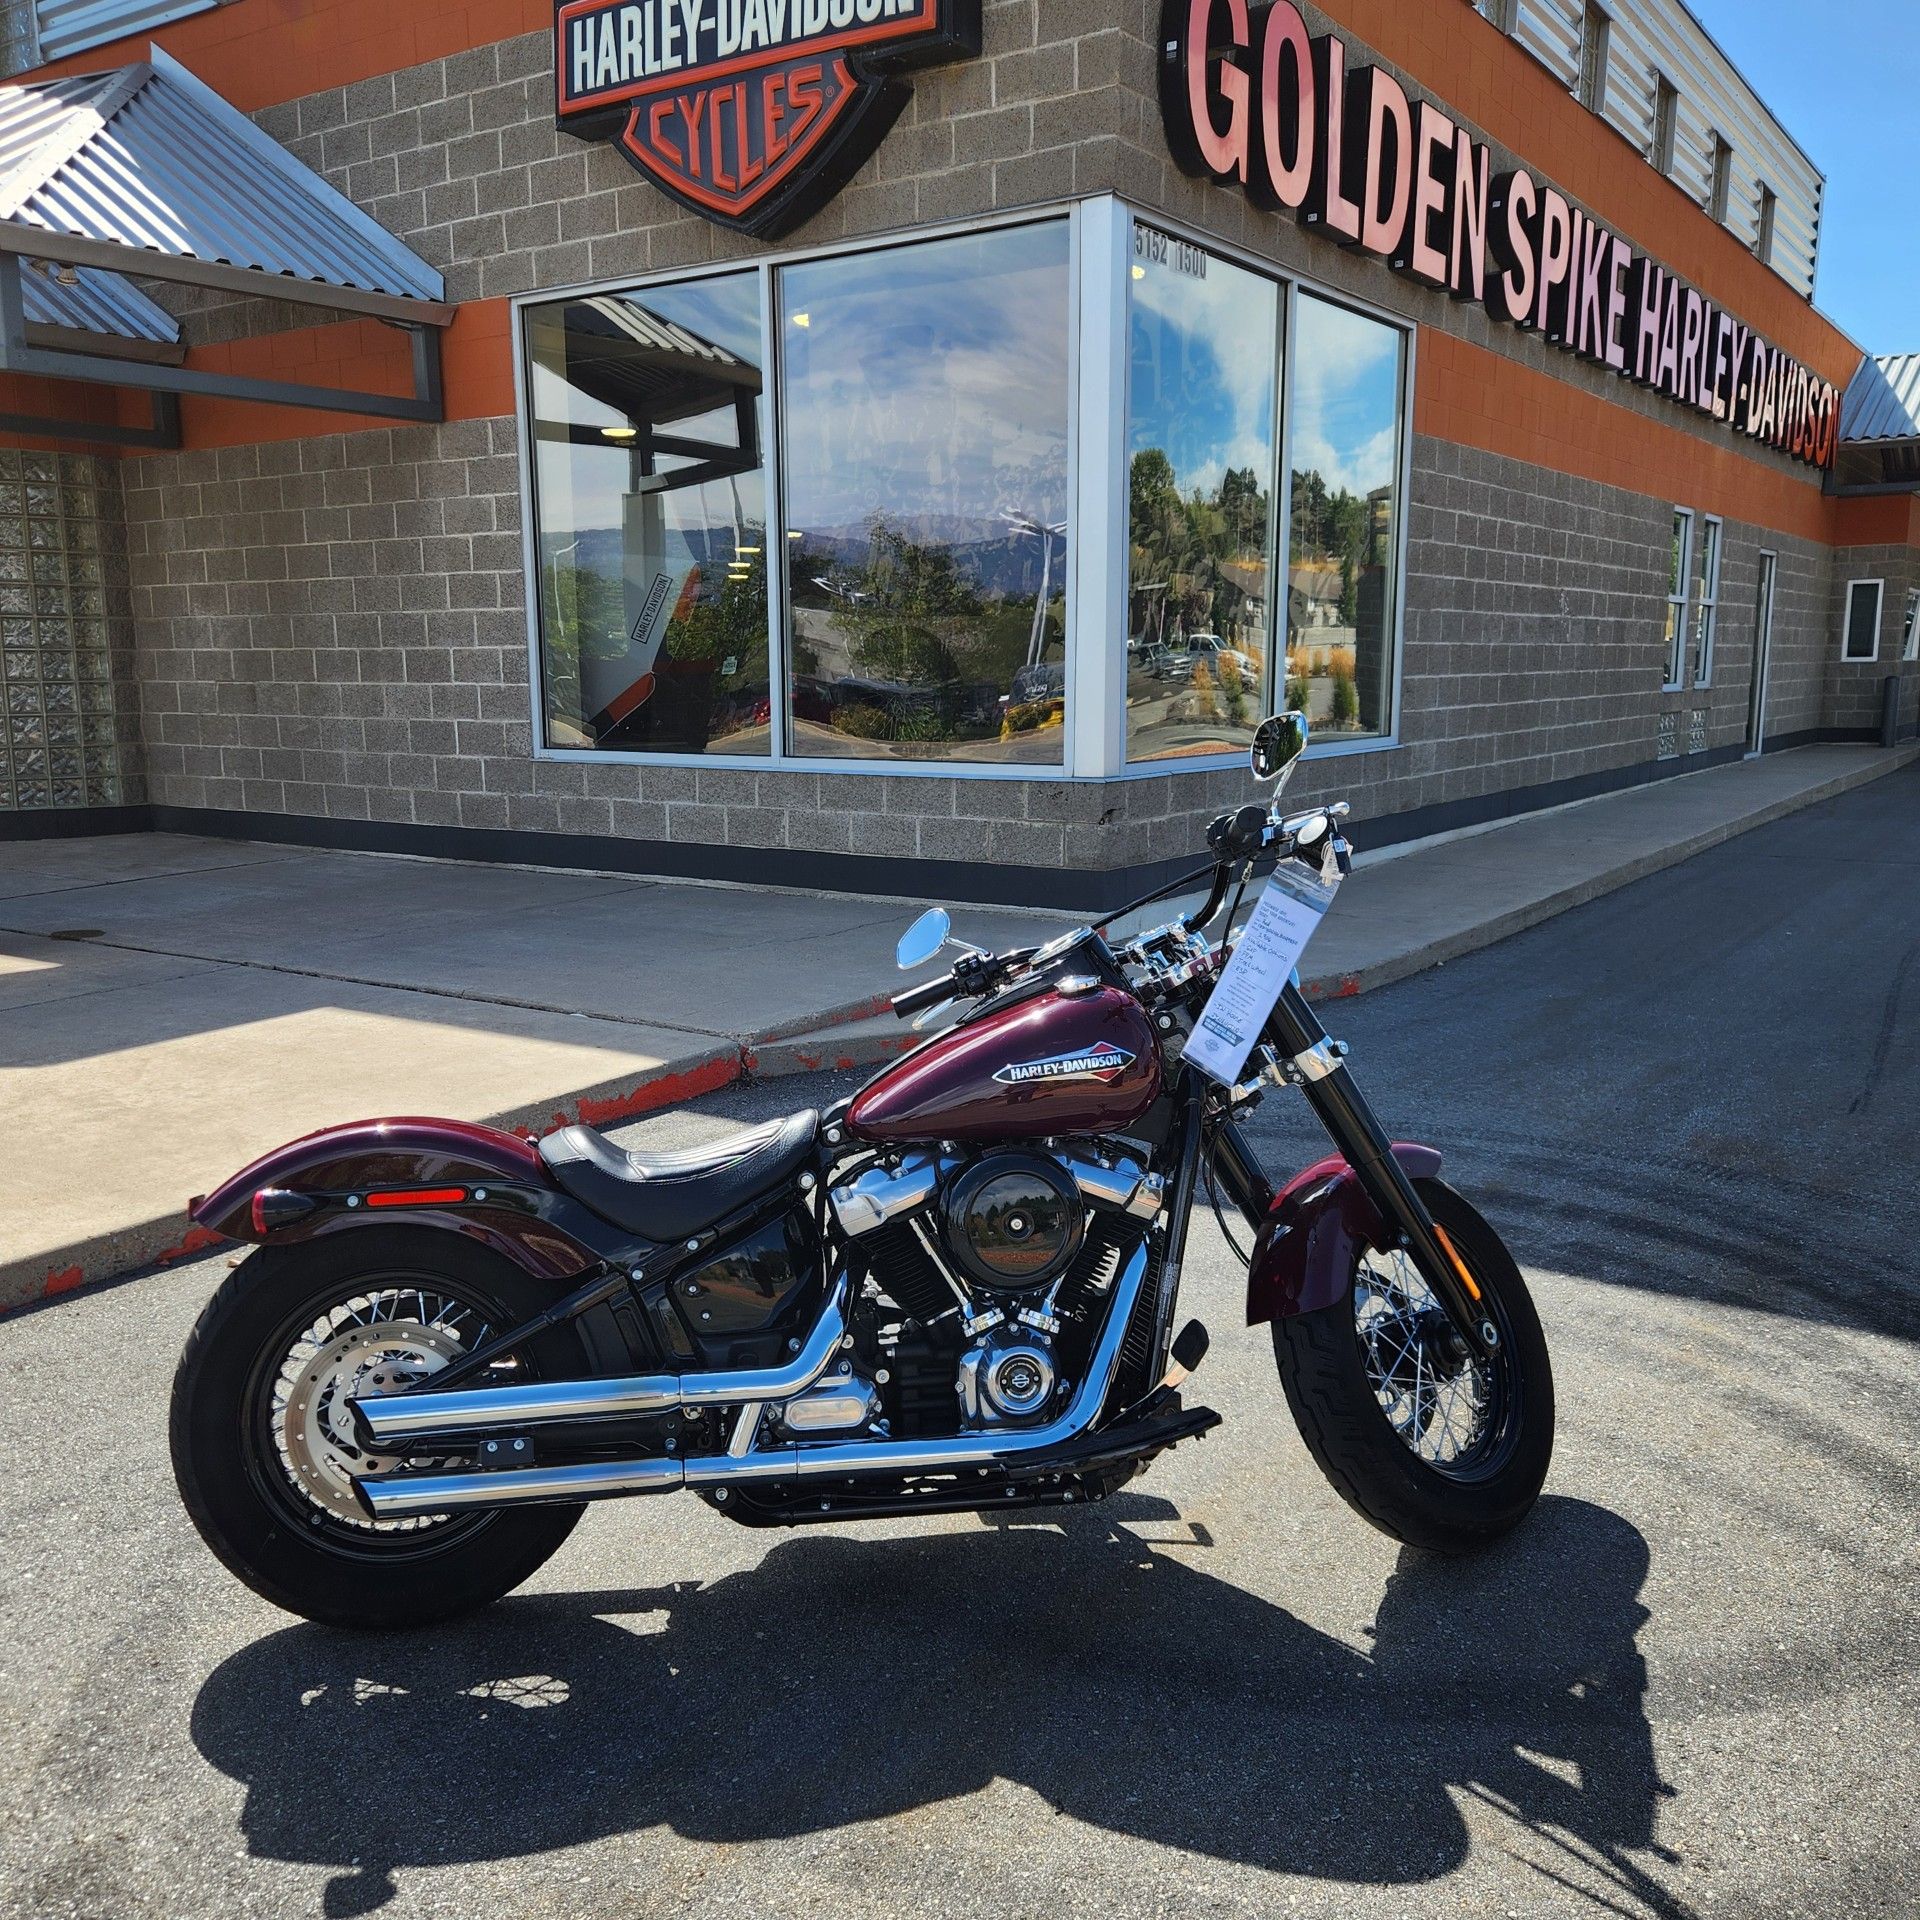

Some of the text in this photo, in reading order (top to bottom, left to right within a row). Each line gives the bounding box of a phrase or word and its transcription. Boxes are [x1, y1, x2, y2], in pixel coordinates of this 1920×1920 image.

[573, 0, 914, 93] HARLEY-DAVID
[650, 63, 823, 193] CYCLES
[1188, 0, 1490, 300] GOLDEN
[1502, 169, 1633, 369] SPIKE
[1135, 225, 1207, 280] 5152 1500
[635, 577, 670, 642] HARLEY-DAVIDSON
[1010, 1054, 1122, 1080] HARLEY-DAVIDSON
